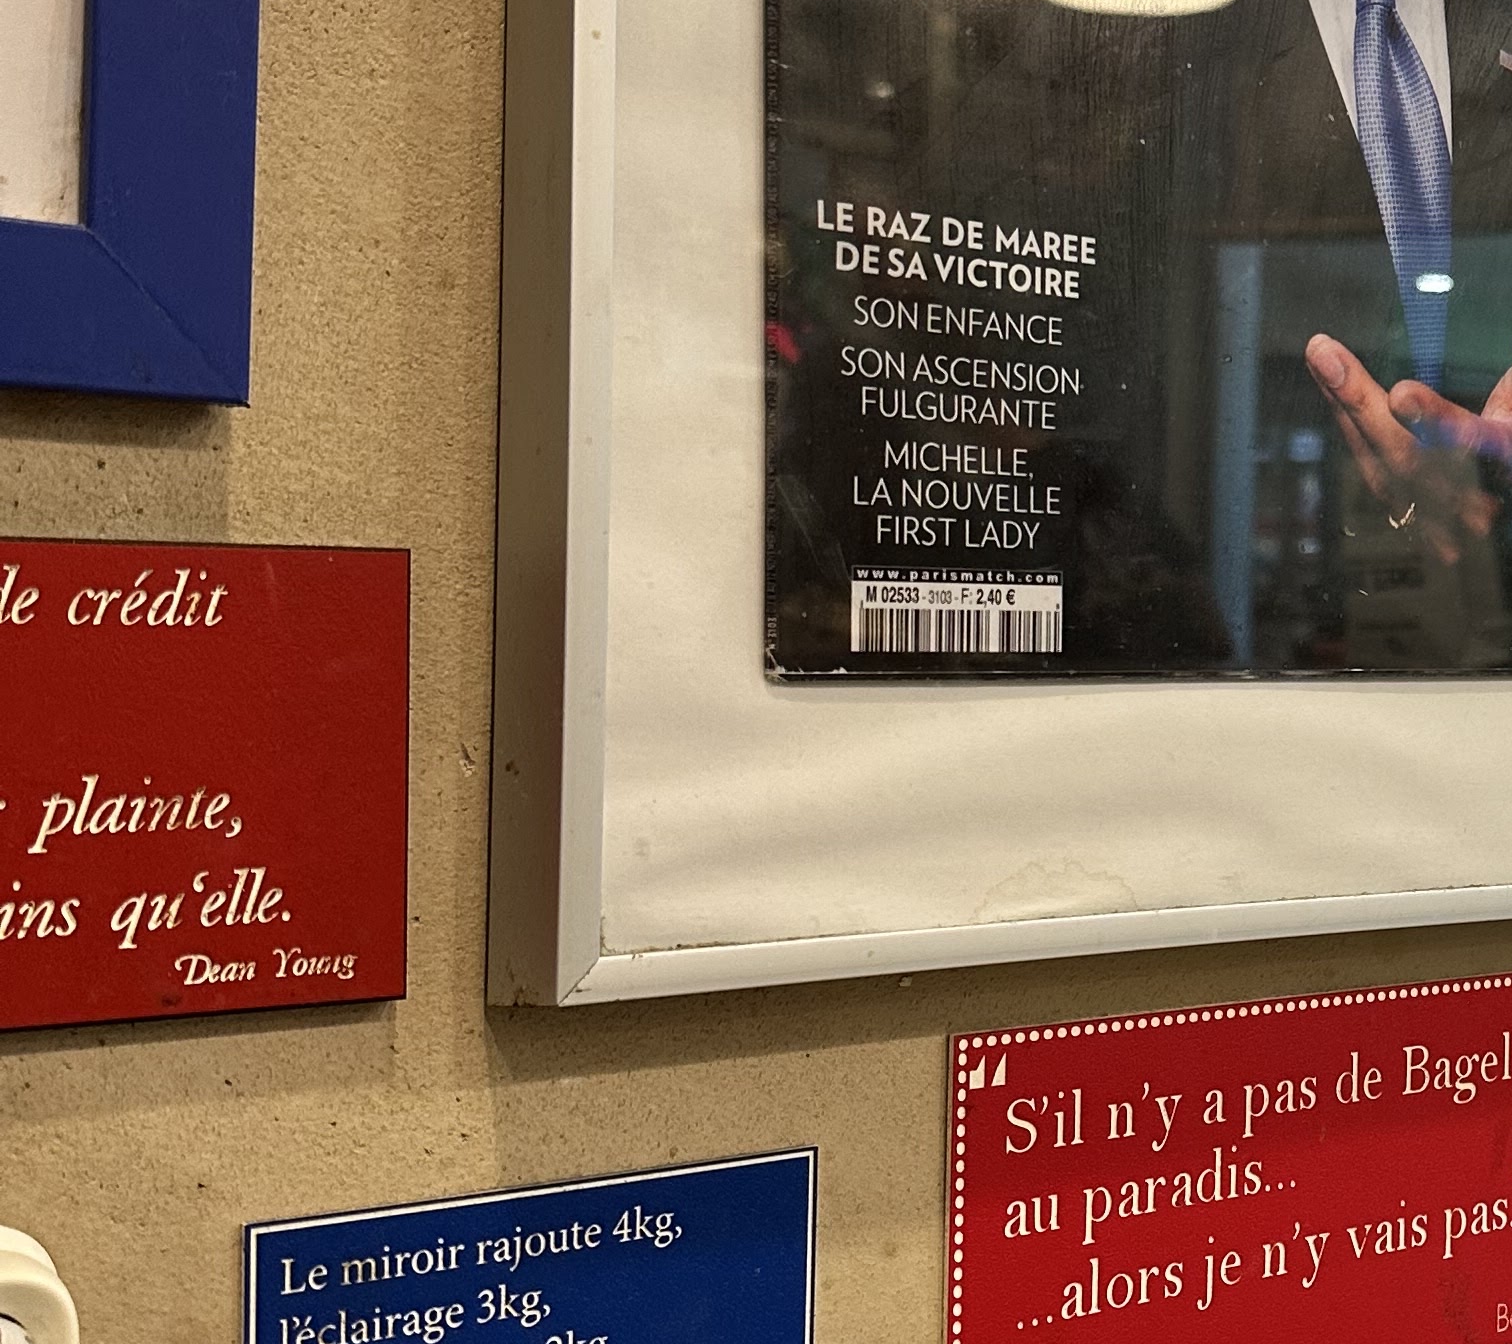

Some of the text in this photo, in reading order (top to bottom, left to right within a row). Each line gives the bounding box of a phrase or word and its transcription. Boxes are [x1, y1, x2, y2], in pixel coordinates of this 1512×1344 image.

[817, 199, 1096, 265] LE RAZ DE MAREE
[836, 240, 1079, 299] DE SA VICTOIRE
[854, 295, 1062, 345] SON ENFANCE
[840, 345, 1079, 395] SON ASCENSION
[862, 386, 1056, 429] FULGURANTE
[884, 440, 1033, 479] MICHELLE,
[854, 475, 1060, 514] LA NOUVELLE
[877, 514, 1040, 549] FIRST LADY
[67, 568, 229, 627] crédit
[856, 568, 1060, 584] www.parismatch.com
[27, 774, 244, 854] plainte,
[110, 867, 292, 950] qu'elle.
[174, 948, 358, 986] Dean Young
[1006, 1088, 1084, 1154] S'il
[1107, 1082, 1182, 1151] n'y
[1203, 1089, 1226, 1124] a
[1242, 1076, 1316, 1138] pas
[1336, 1051, 1382, 1104] de
[1004, 1145, 1296, 1245] au paradis...
[280, 1205, 682, 1295] Le miroir rajoute 4kg,
[1017, 1258, 1183, 1329] ...alors
[1196, 1236, 1240, 1310] je
[1262, 1222, 1330, 1288] n'y
[1346, 1200, 1427, 1258] vais
[476, 1284, 550, 1327] 3kg,
